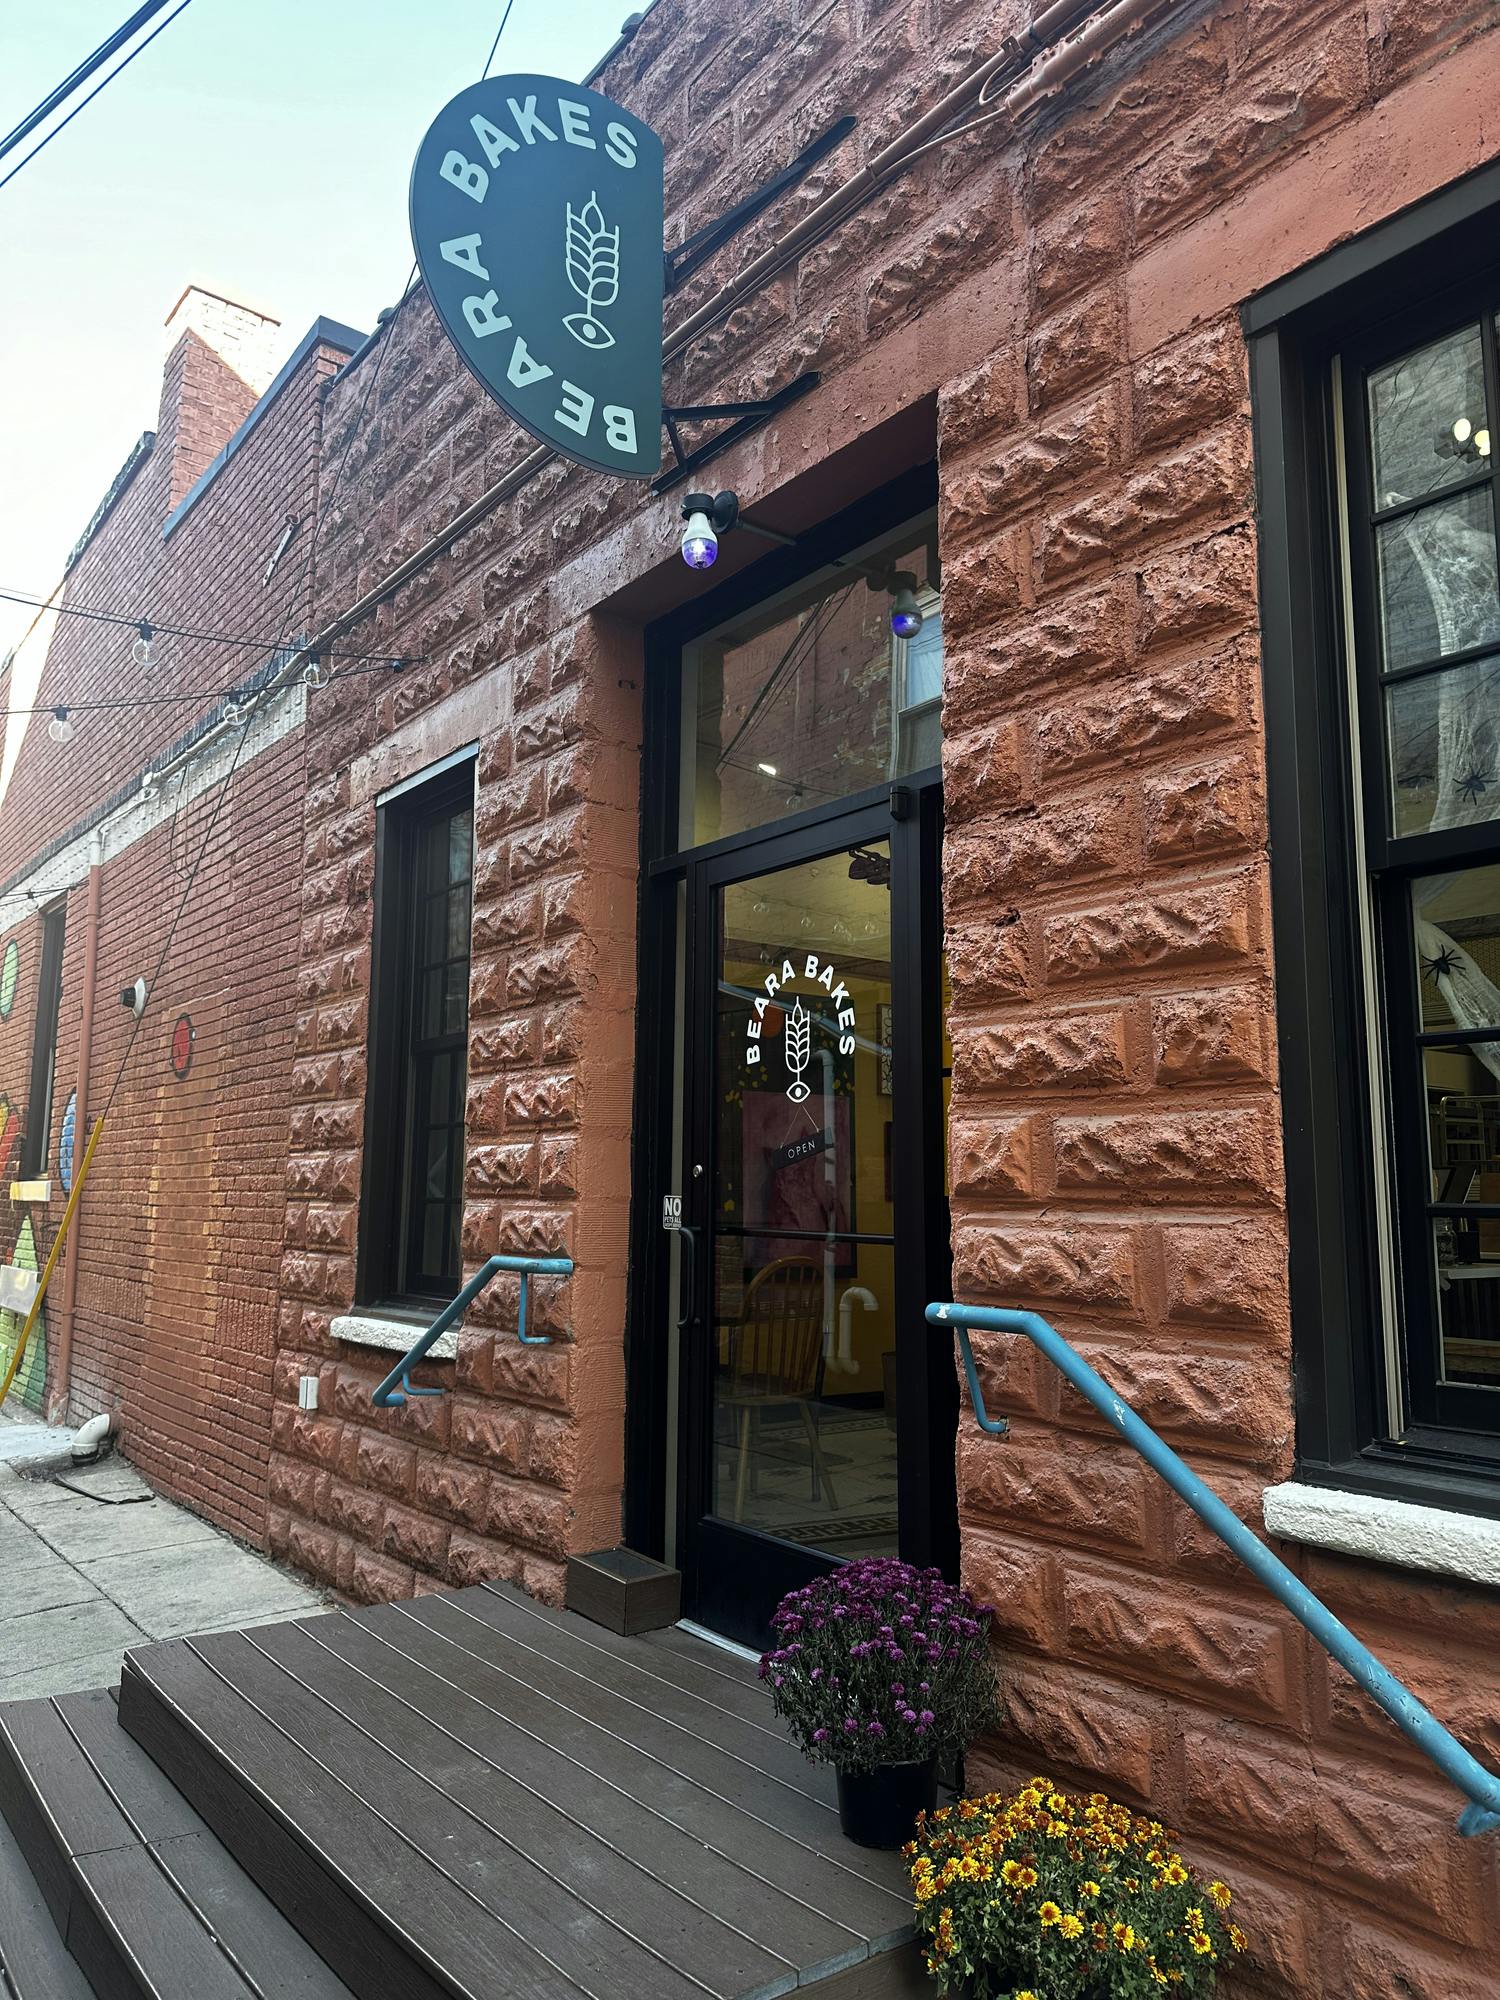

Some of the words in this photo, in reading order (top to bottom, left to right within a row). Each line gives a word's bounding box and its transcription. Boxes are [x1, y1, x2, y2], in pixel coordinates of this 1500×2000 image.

[440, 95, 638, 203] BAKES
[440, 232, 638, 454] BEARA
[746, 960, 796, 1064] BEARA
[804, 954, 856, 1055] BAKES
[787, 1140, 816, 1159] OPEN
[665, 1198, 681, 1216] NO
